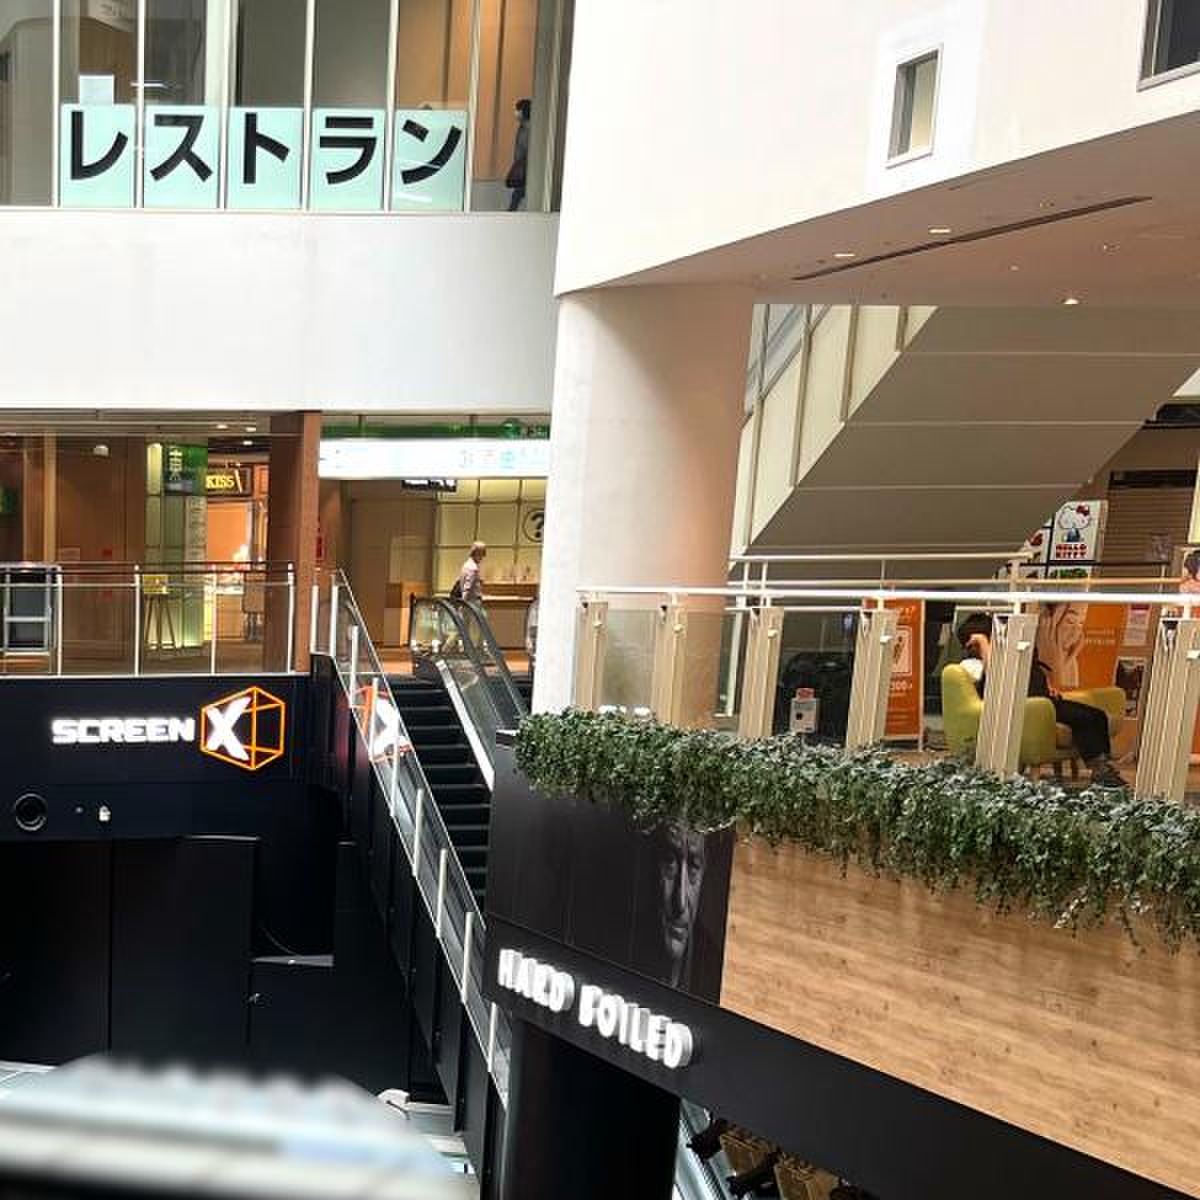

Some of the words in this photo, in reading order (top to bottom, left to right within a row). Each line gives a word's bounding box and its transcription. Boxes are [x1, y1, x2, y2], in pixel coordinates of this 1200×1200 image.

[70, 110, 464, 186] レストラン
[51, 717, 196, 744] SCREEN
[205, 696, 252, 762] X
